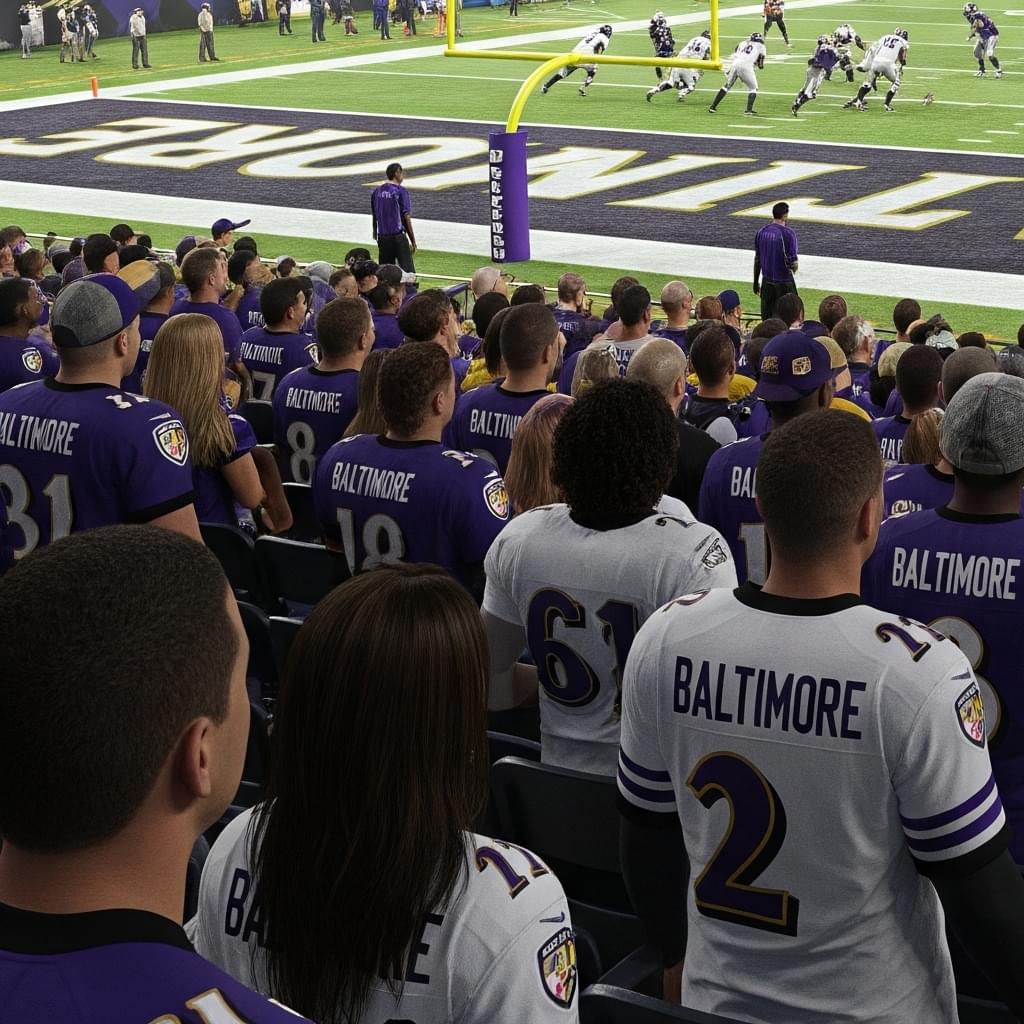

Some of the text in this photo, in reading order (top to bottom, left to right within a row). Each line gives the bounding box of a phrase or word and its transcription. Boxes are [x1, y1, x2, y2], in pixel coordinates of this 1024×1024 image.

[287, 421, 317, 485] 8
[331, 462, 416, 503] BALTIMORE
[891, 547, 1021, 600] BALTIMORE
[528, 587, 640, 711] 61
[673, 656, 867, 739] BALTIMORE
[687, 750, 799, 937] 2
